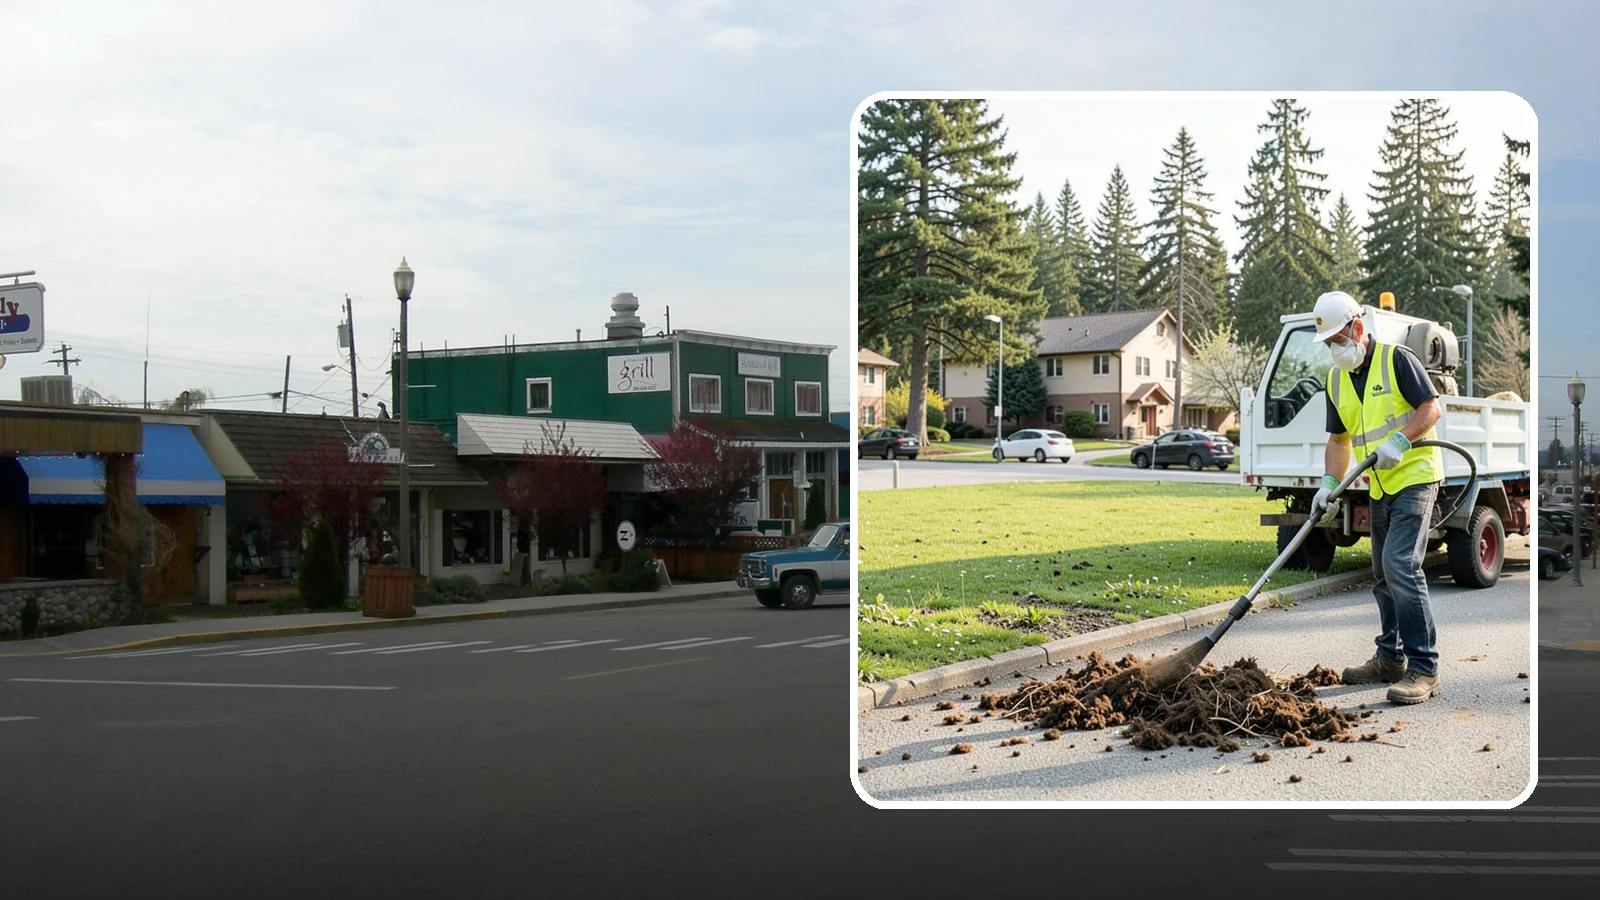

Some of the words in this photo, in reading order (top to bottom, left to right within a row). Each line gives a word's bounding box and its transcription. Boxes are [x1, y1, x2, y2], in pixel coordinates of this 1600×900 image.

[0, 297, 19, 323] ly
[20, 337, 38, 345] Salads
[617, 356, 655, 391] grill
